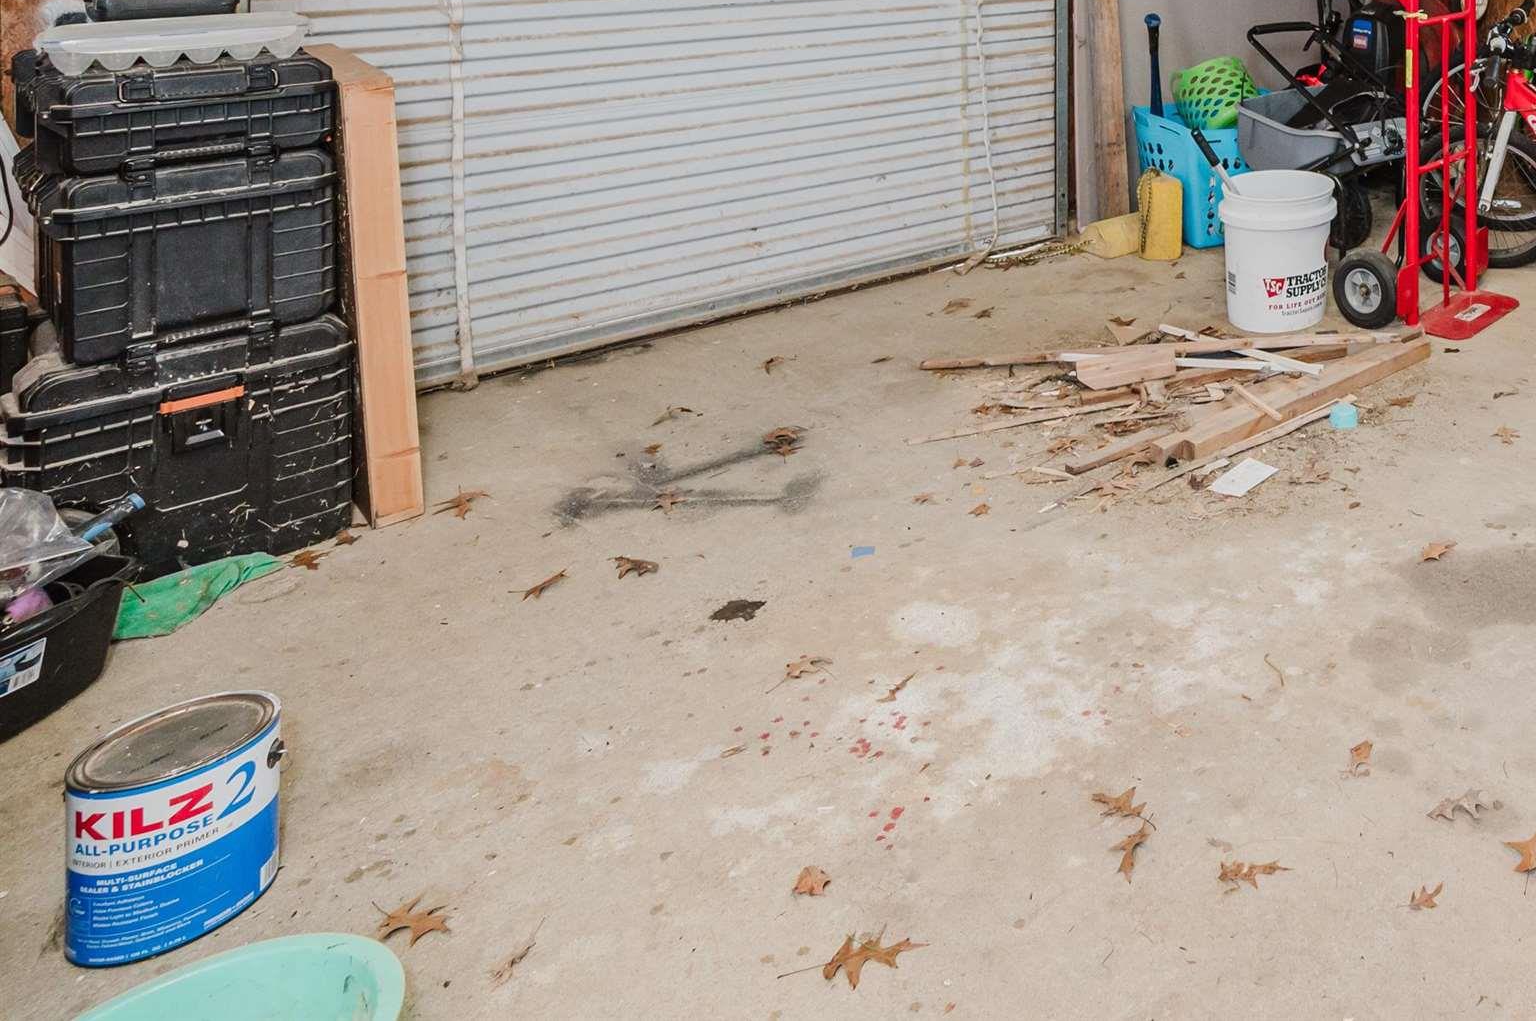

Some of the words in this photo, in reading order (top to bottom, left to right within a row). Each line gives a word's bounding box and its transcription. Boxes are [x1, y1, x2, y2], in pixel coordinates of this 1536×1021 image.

[1265, 279, 1283, 295] TSC
[75, 782, 214, 841] KILZ
[216, 760, 256, 821] 2
[74, 813, 214, 857] ALL-PURPOSE
[115, 847, 173, 868] EXTERIOR
[177, 827, 220, 851] PRIMER
[96, 862, 178, 887] MULTI-SURFACE
